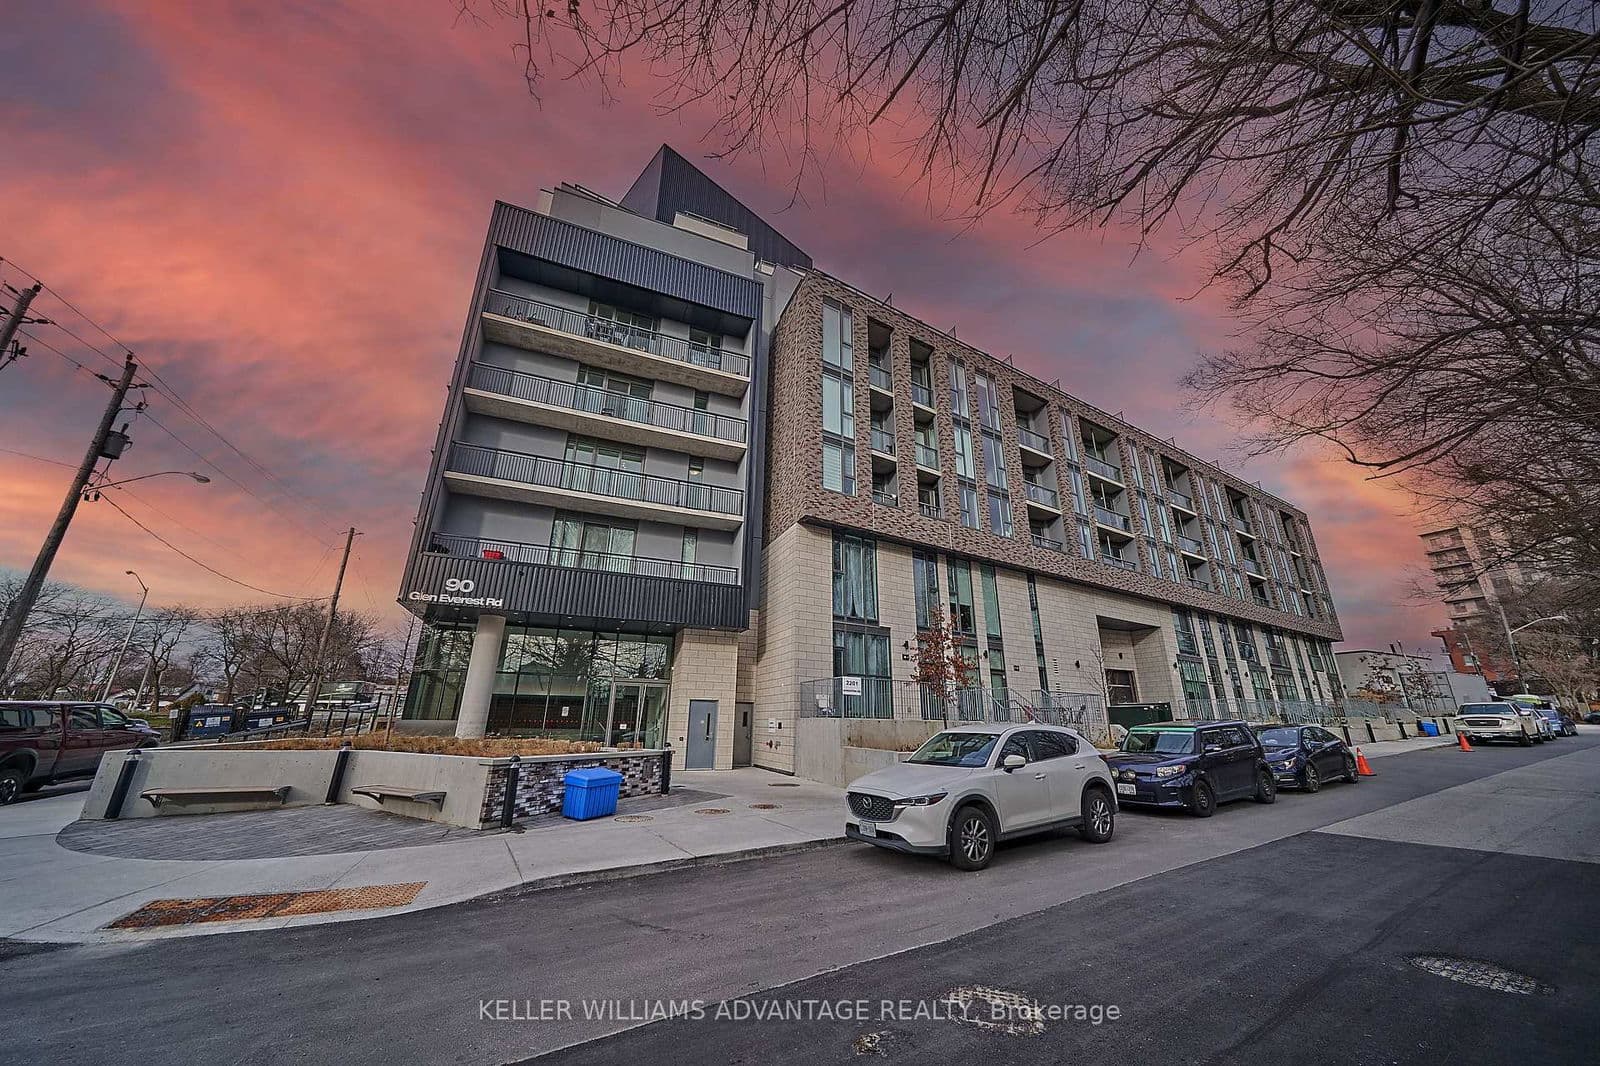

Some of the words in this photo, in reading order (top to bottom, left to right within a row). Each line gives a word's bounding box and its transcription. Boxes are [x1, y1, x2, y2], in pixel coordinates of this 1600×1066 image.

[445, 578, 475, 593] 90
[409, 591, 438, 602] Glen
[438, 593, 485, 606] Everest
[485, 597, 503, 607] Rd
